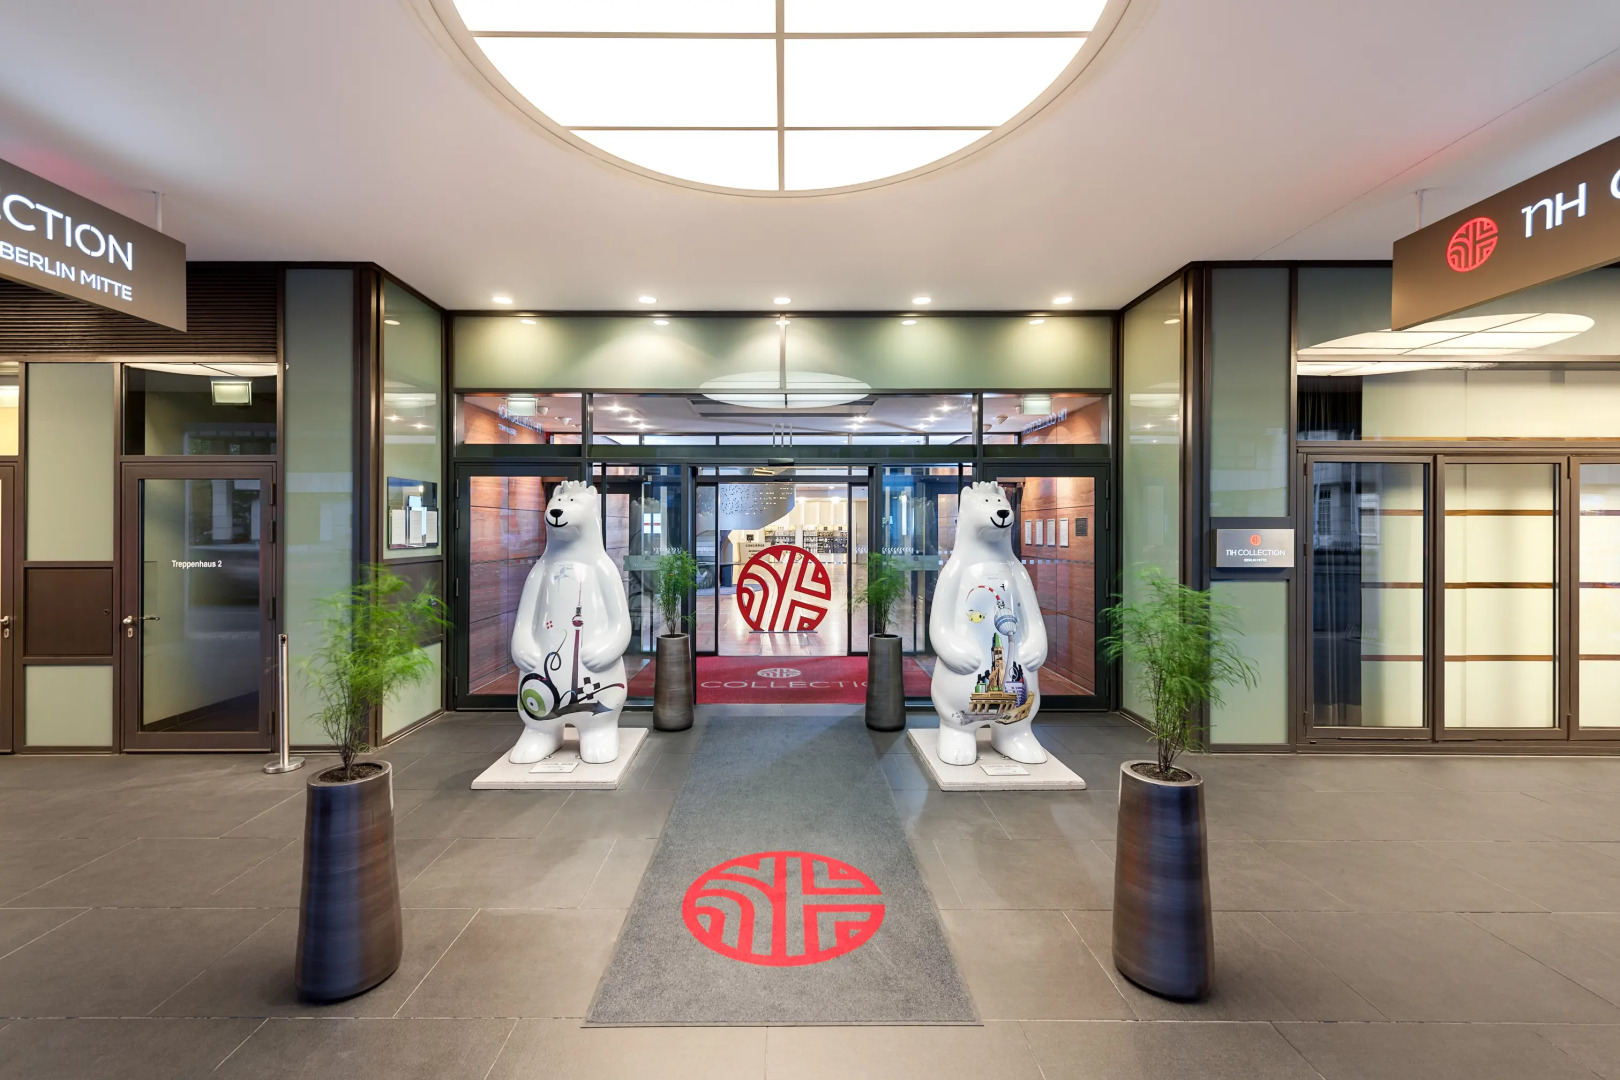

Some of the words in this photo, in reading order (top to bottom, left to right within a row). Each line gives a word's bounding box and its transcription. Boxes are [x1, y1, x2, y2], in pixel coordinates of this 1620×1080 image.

[0, 194, 133, 271] CTION
[0, 241, 76, 282] BERLIN
[80, 269, 133, 302] MITTE
[171, 560, 216, 569] Treppenhaus
[217, 560, 222, 568] 2
